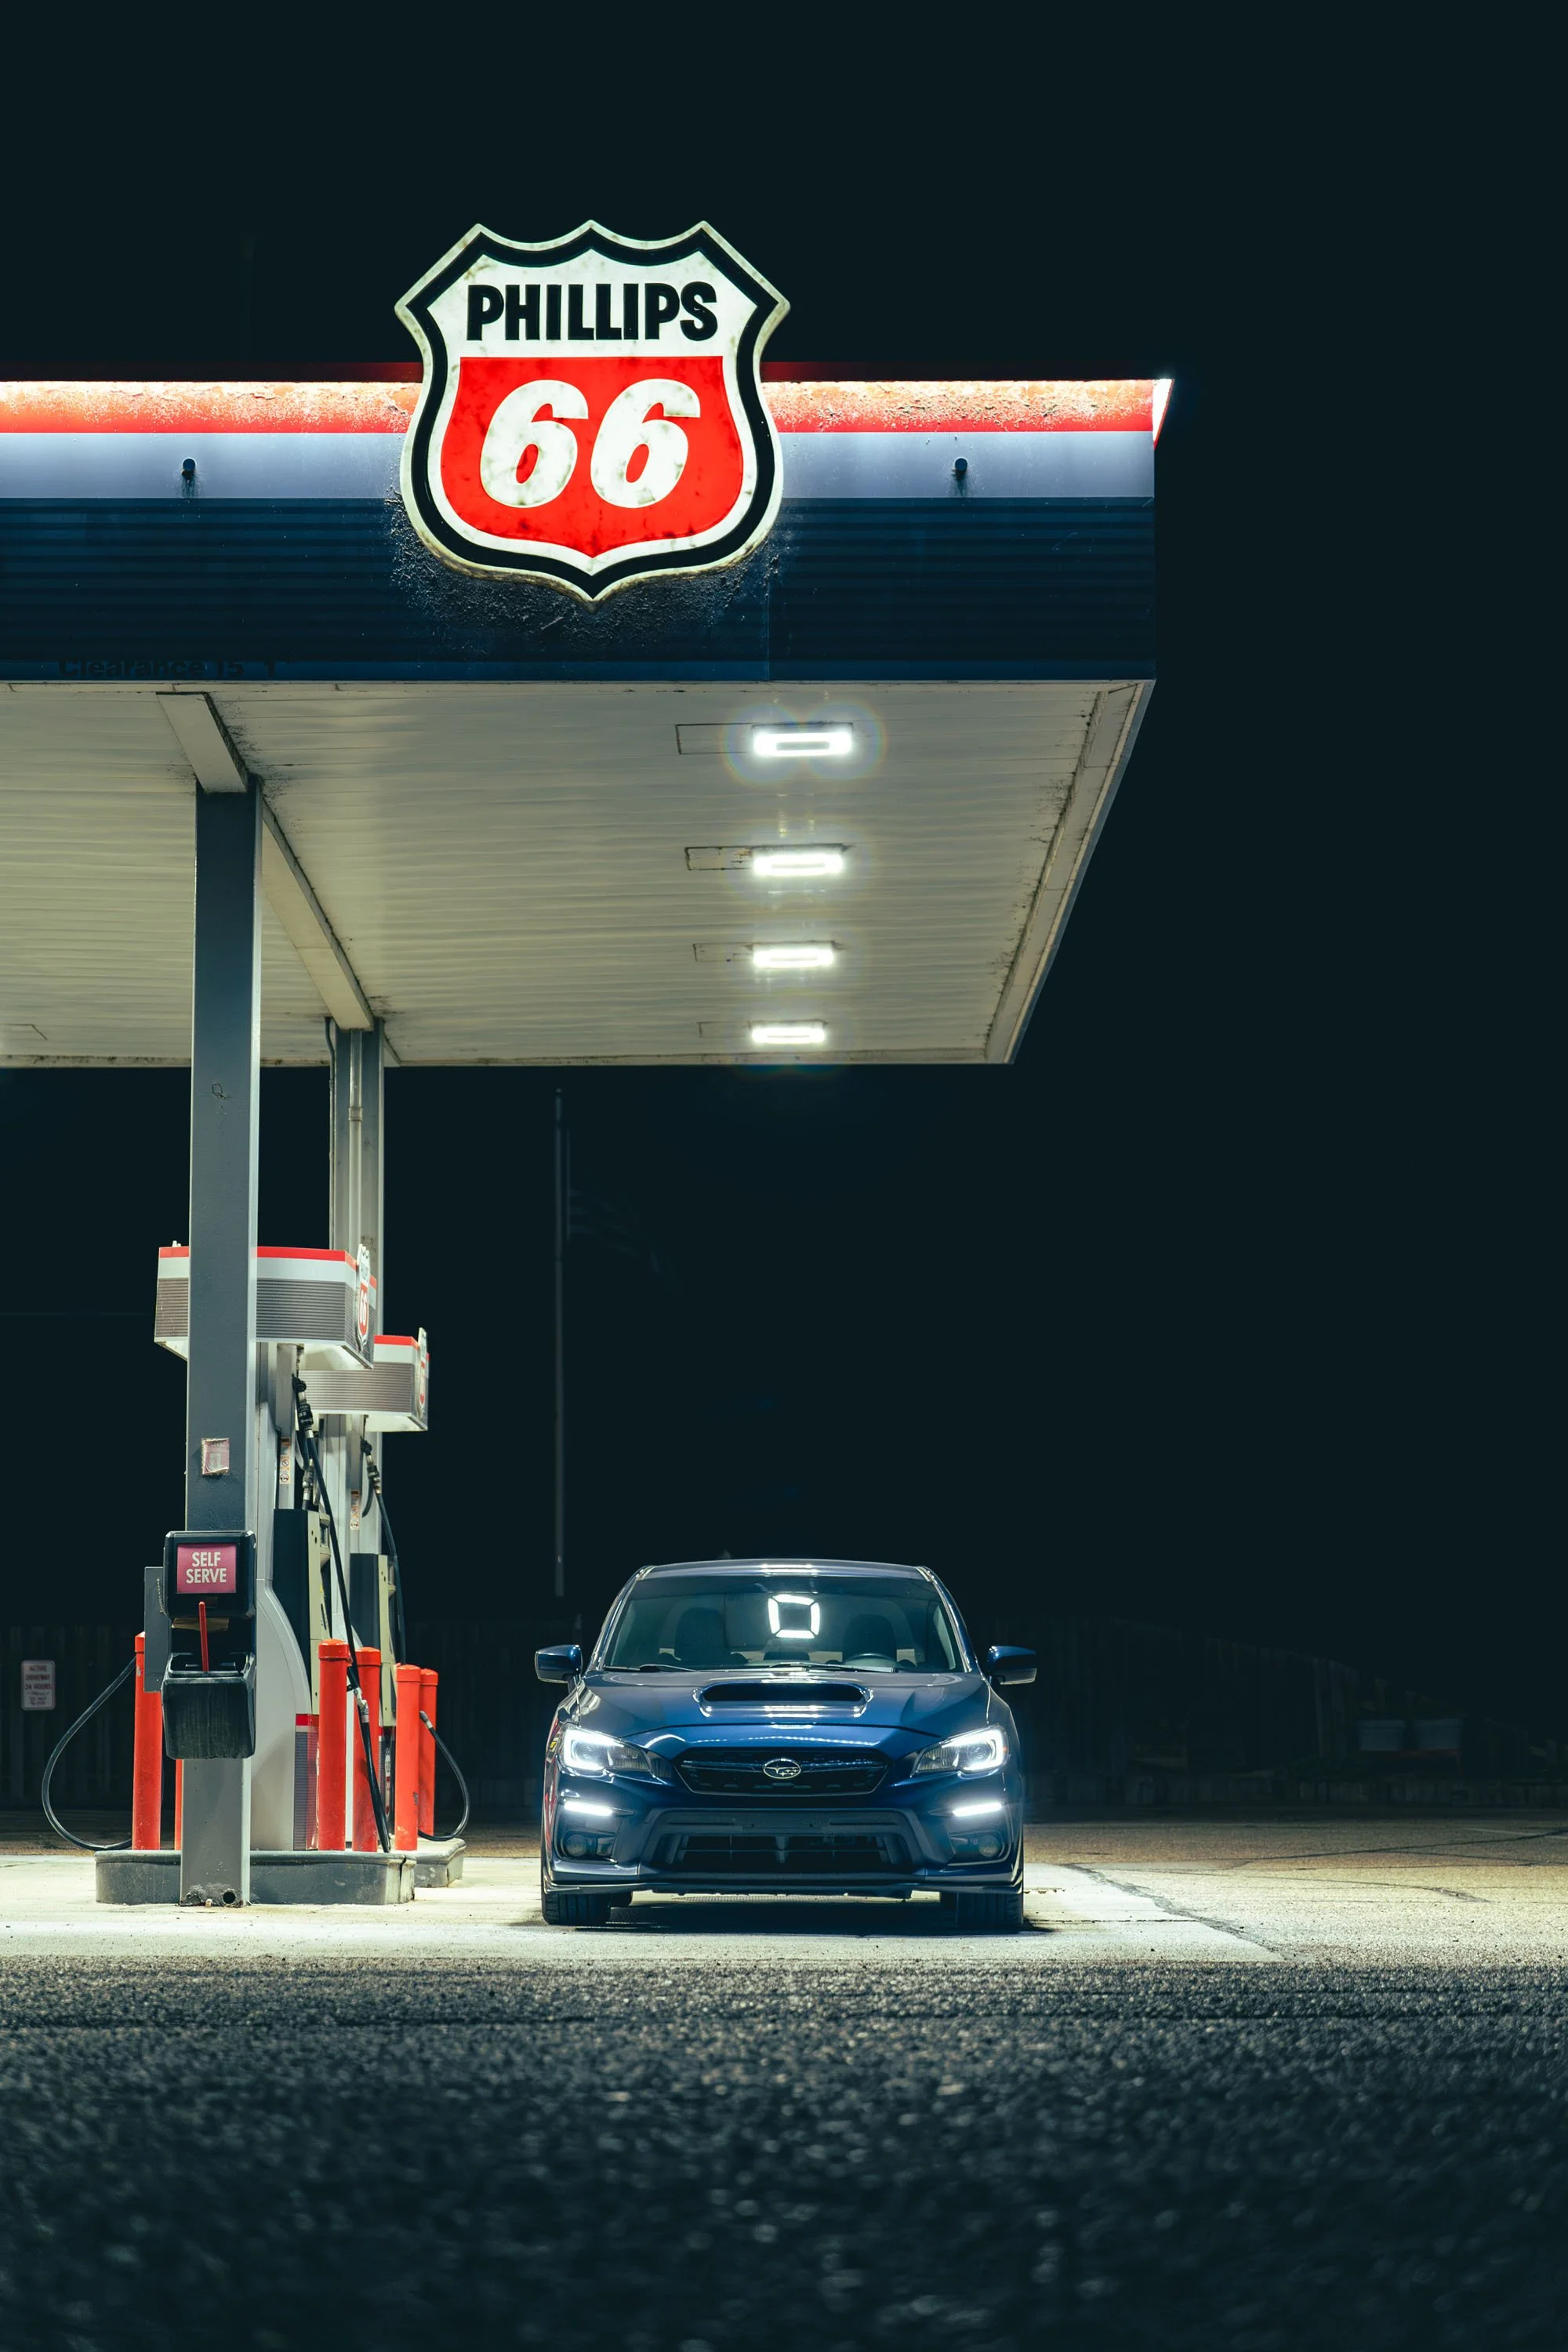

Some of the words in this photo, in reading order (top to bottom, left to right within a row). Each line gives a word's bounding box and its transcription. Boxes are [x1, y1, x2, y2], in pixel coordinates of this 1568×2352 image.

[466, 281, 718, 341] PHILLIPS
[480, 379, 701, 508] 66
[58, 657, 205, 677] Clearance
[191, 1552, 221, 1567] SELF
[186, 1568, 227, 1584] SERVE
